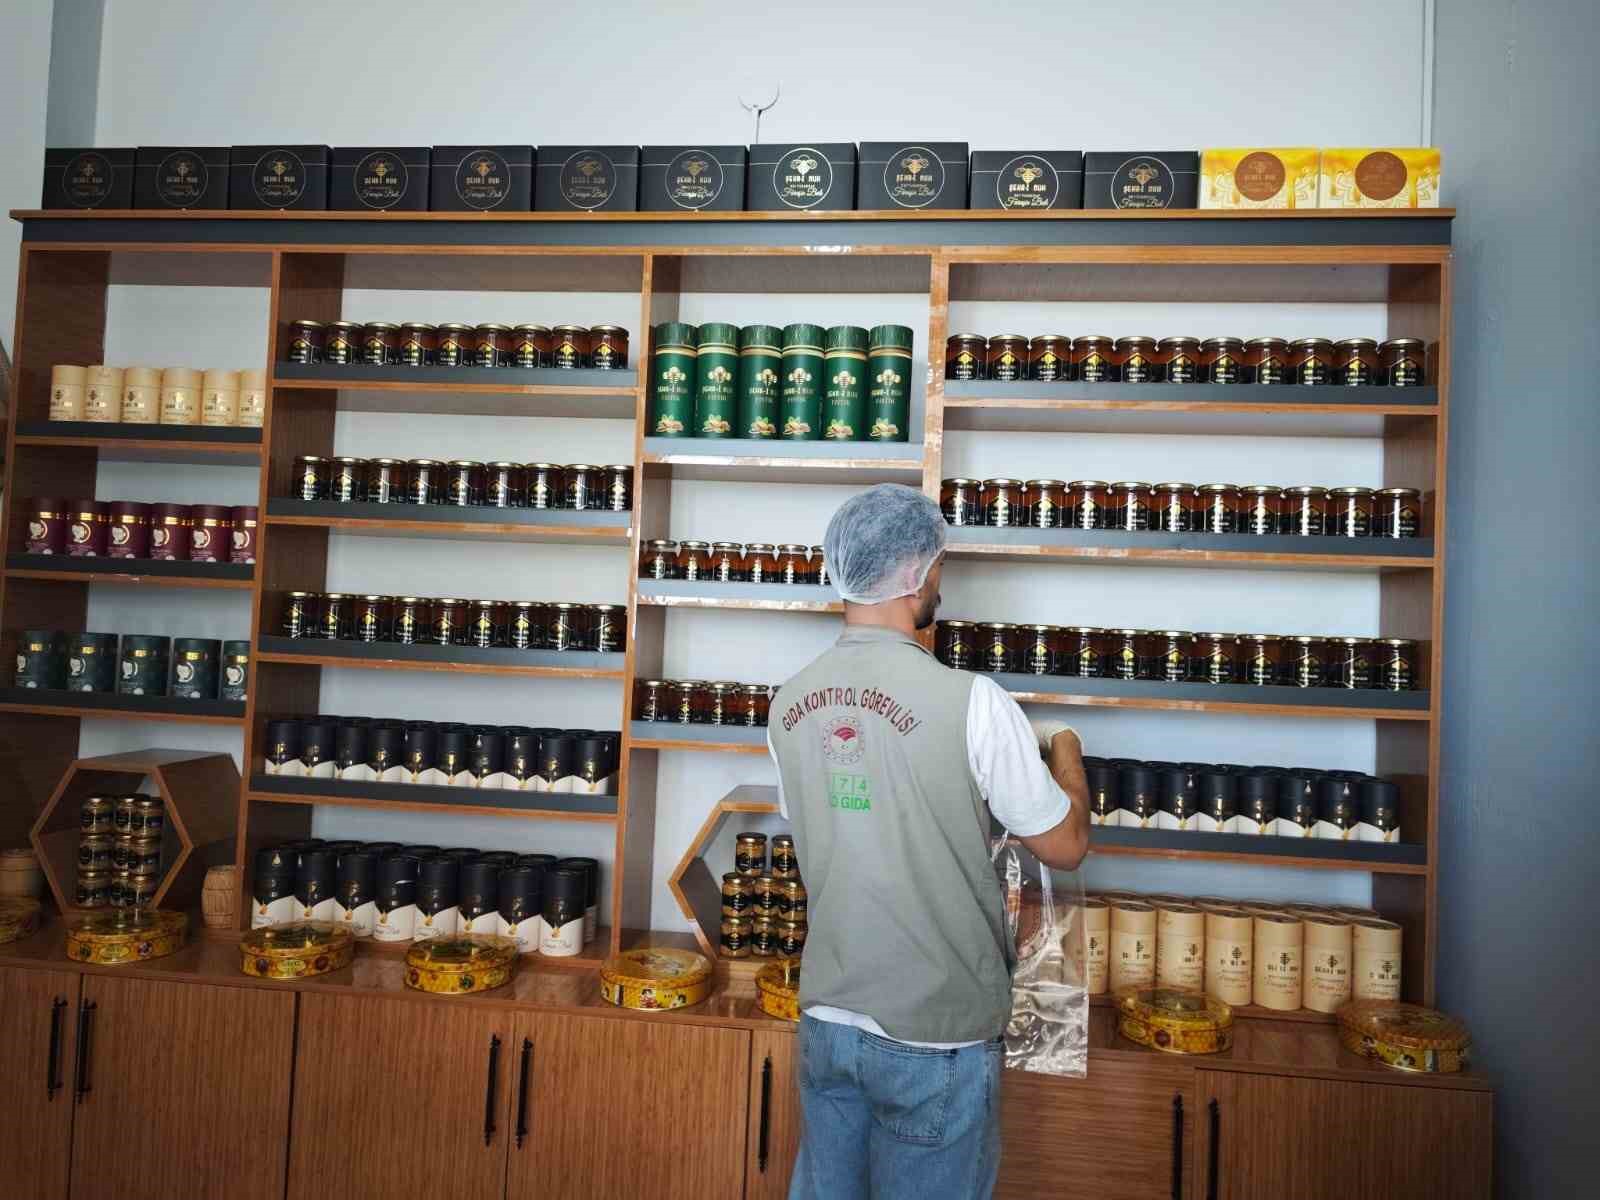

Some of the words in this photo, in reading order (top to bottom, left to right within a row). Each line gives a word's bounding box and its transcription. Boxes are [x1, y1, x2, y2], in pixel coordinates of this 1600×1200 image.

[783, 702, 805, 732] GIDA
[803, 687, 857, 713] KONTROL
[860, 687, 922, 737] GÖREVLİSİ
[840, 795, 872, 811] GIDA
